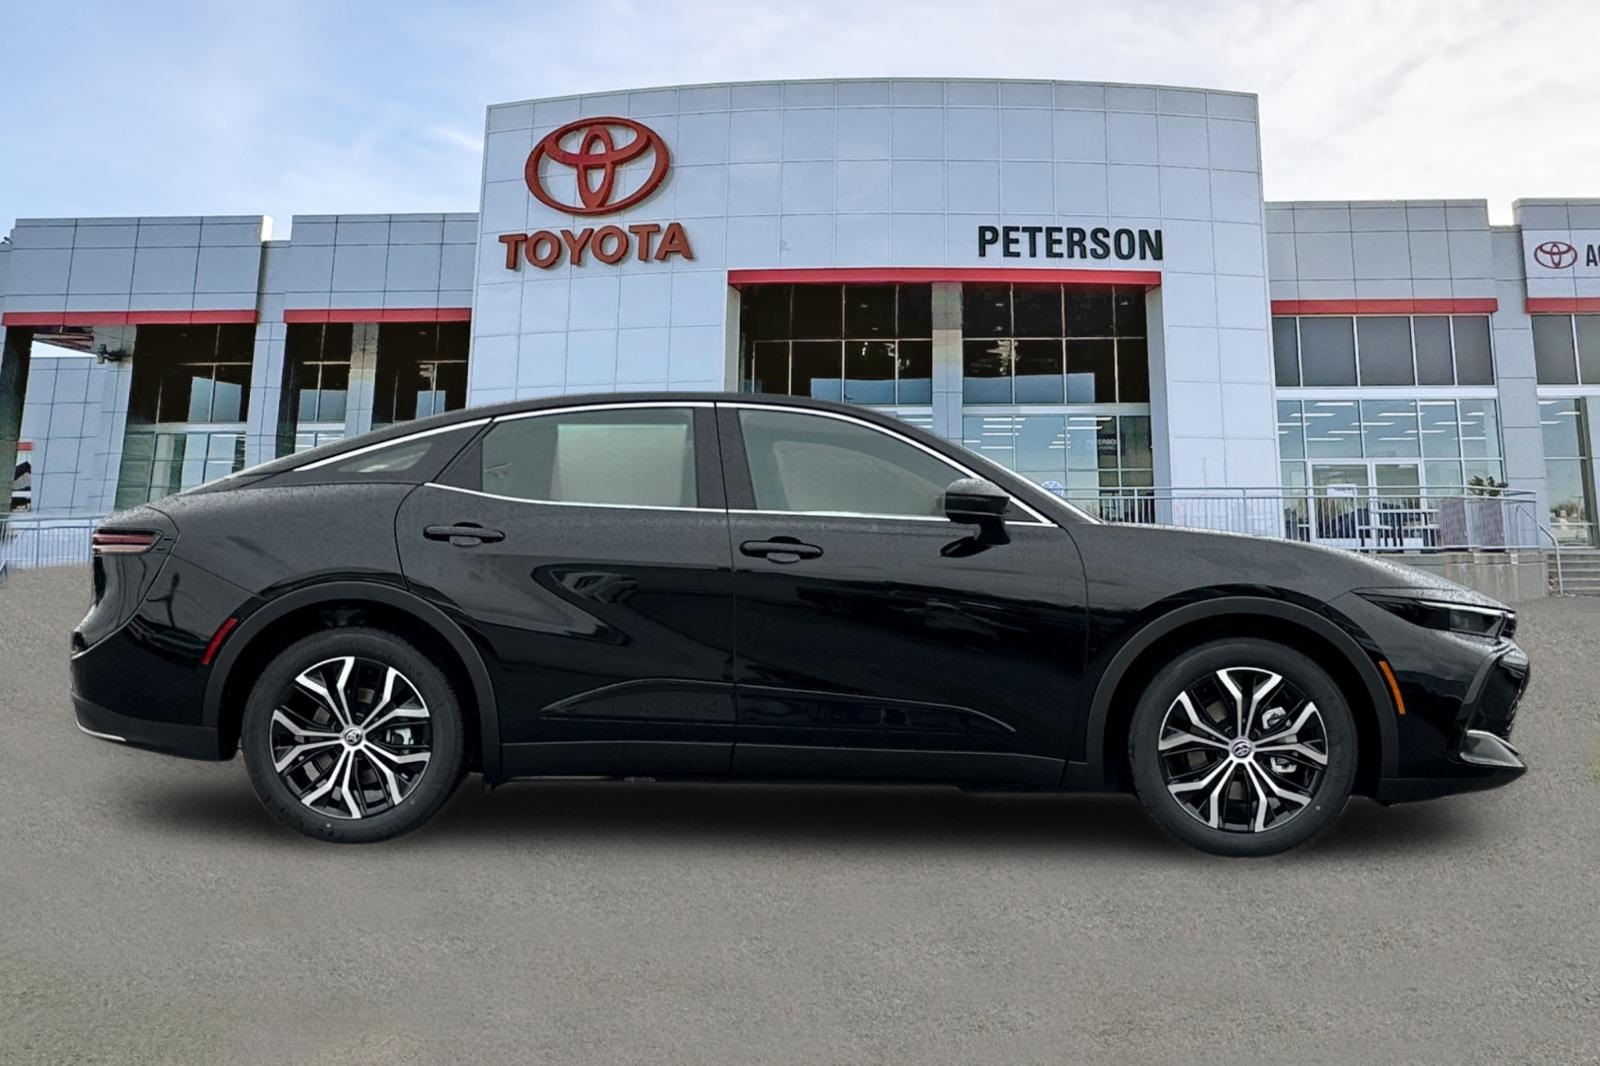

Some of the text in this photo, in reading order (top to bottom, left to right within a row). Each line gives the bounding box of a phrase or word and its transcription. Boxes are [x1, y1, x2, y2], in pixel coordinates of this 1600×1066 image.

[498, 222, 693, 269] TOYOTA
[978, 225, 1163, 260] PETERSON
[1586, 244, 1600, 267] A
